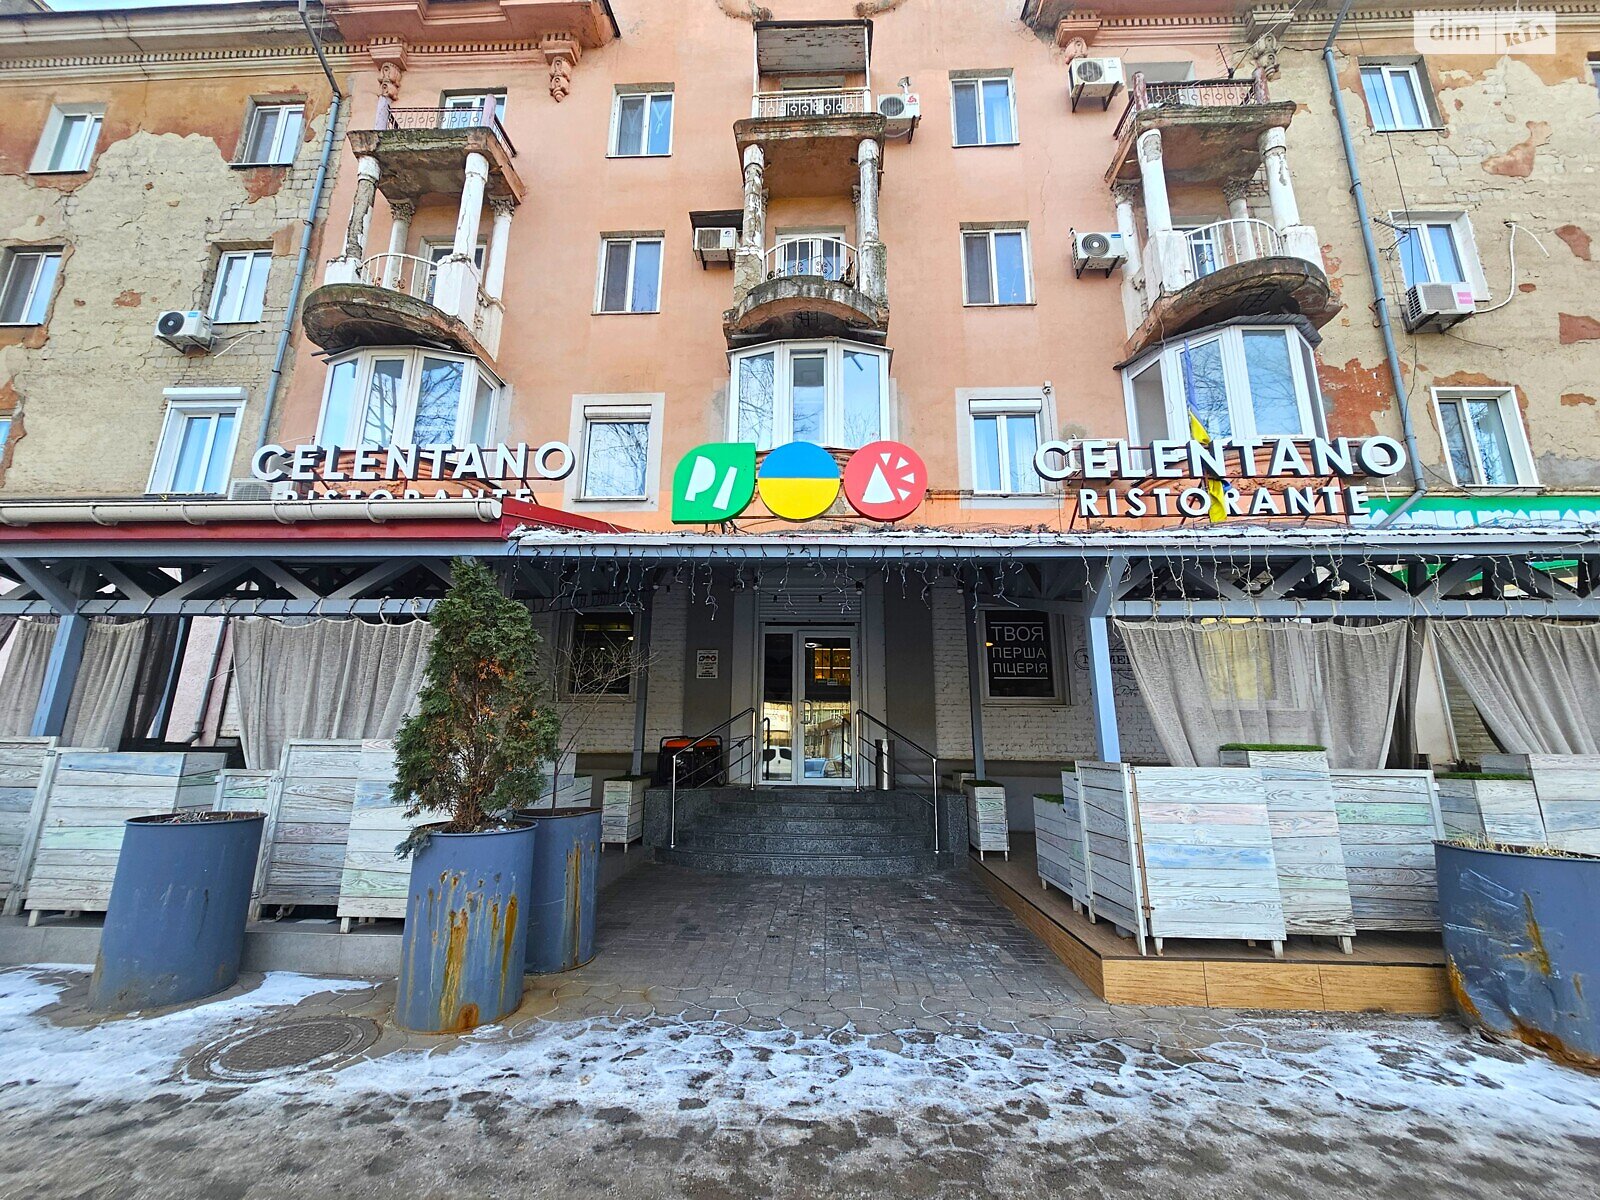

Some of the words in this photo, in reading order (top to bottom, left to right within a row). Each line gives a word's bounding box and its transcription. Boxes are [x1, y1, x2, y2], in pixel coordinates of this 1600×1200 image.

[251, 441, 575, 482] CELENTANO
[1033, 436, 1407, 482] CELENTANO
[1078, 486, 1371, 518] RISTORANTE
[990, 626, 1044, 642] ТВОЯ
[992, 647, 1047, 659] ПЕРША
[993, 662, 1048, 676] ПІЦЕРІЯ
